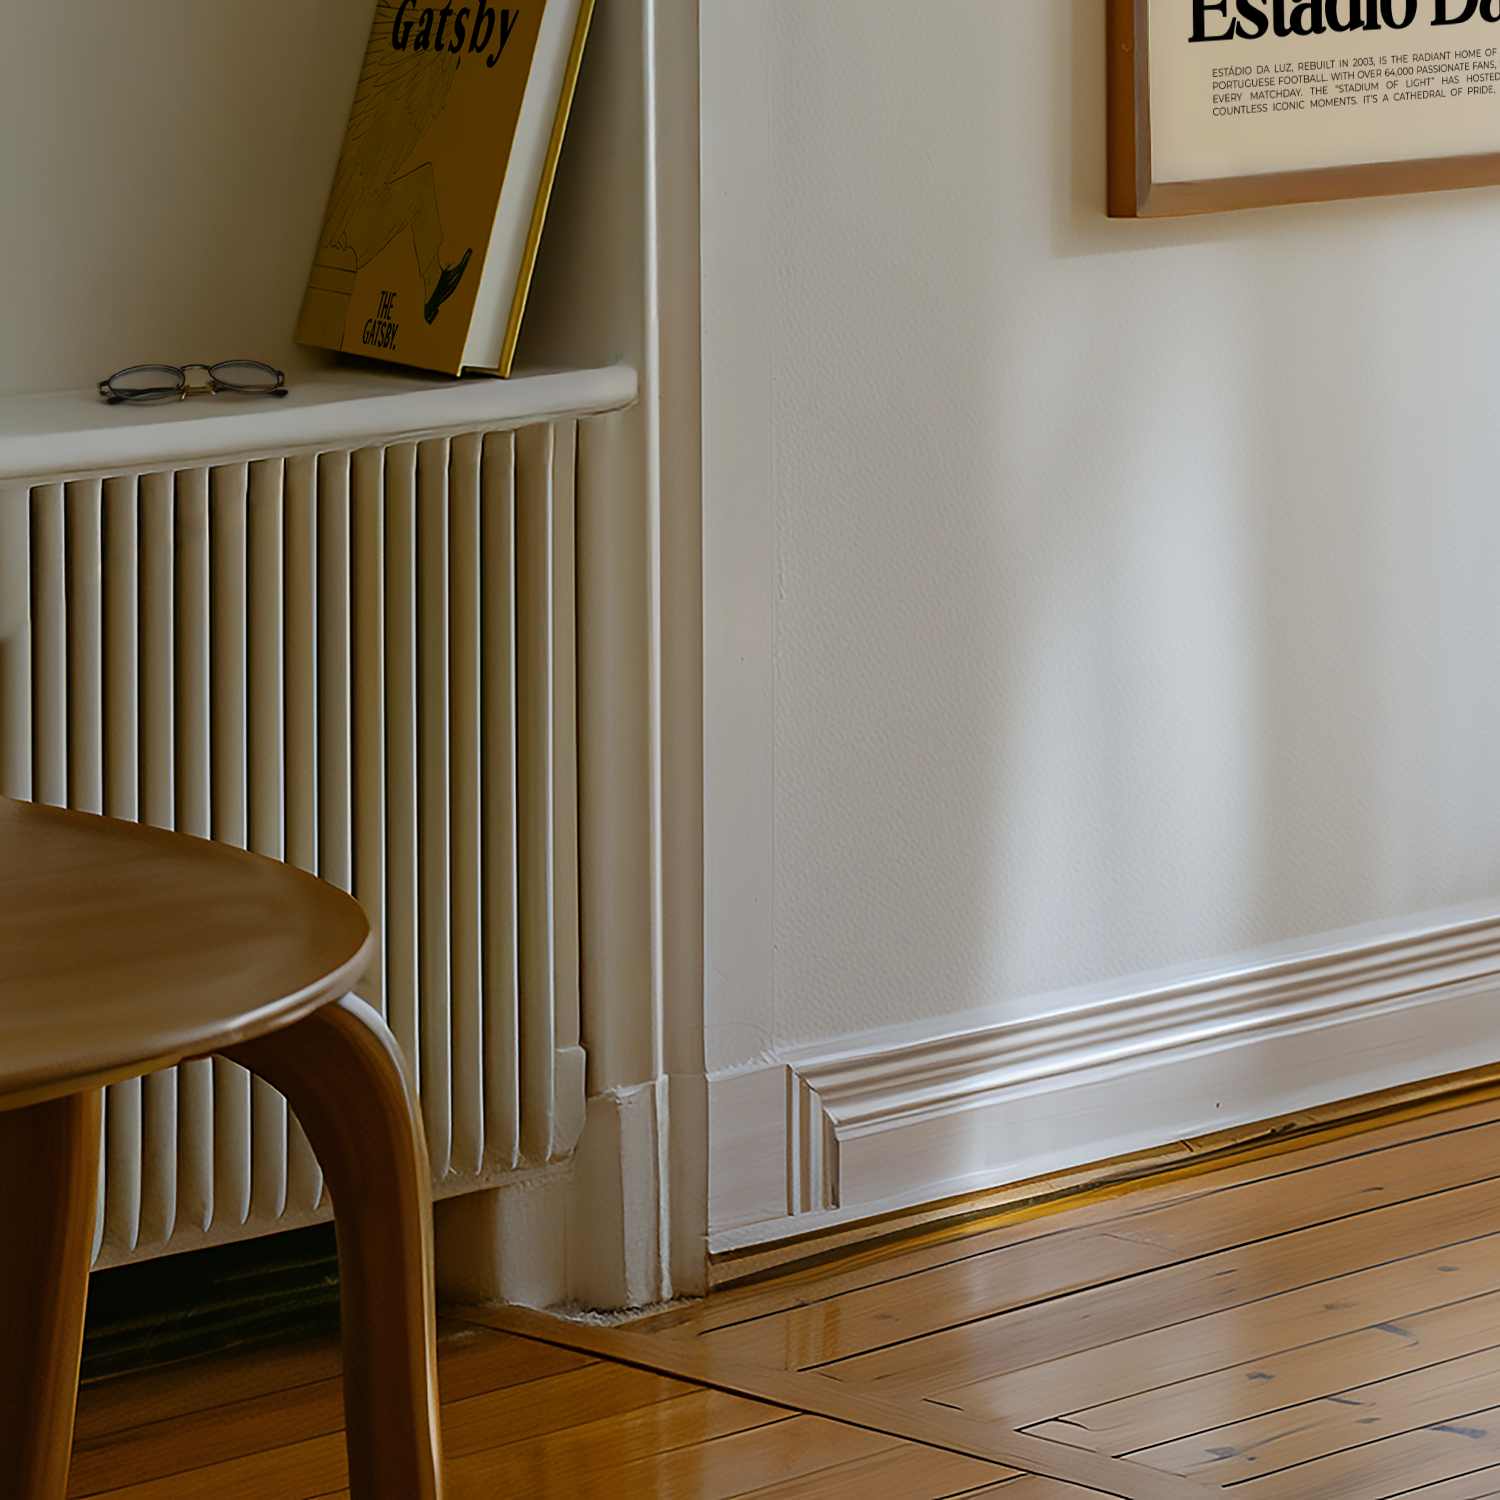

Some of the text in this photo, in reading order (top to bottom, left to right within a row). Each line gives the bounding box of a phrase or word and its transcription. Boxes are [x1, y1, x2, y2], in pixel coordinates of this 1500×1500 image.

[1212, 66, 1253, 78] ESTÁDIO
[1256, 65, 1271, 75] DA
[1274, 63, 1294, 74] LUZ,
[1297, 60, 1336, 71] REBUILT
[1339, 59, 1349, 68] IN
[1352, 57, 1376, 68] 2003,
[1379, 56, 1388, 65] IS
[1390, 55, 1409, 64] THE
[1412, 51, 1452, 63] RADIANT
[1454, 49, 1482, 60] HOME
[1484, 48, 1498, 58] OF
[1212, 77, 1276, 91] PORTUGUESE
[1278, 74, 1329, 86] FOOTBALL.
[1330, 71, 1355, 82] WITH
[1356, 69, 1382, 80] OVER
[1384, 67, 1415, 78] 64,000
[1416, 62, 1470, 75] PASSIONATE
[1472, 60, 1497, 71] FANS,
[1212, 93, 1243, 104] EVERY
[1249, 88, 1303, 101] MATCHDAY.
[1309, 86, 1328, 96] THE
[1385, 80, 1399, 90] OF
[1441, 75, 1460, 85] HAS
[1212, 104, 1268, 117] COUNTLESS
[1272, 101, 1305, 112] ICONIC
[1309, 96, 1359, 109] MOMENTS.
[1382, 94, 1390, 103] A
[1393, 90, 1447, 102] CATHEDRAL
[1449, 88, 1463, 97] OF
[1467, 85, 1496, 96] PRIDE,
[376, 290, 397, 320] THE
[362, 318, 399, 350] GATSBY.
